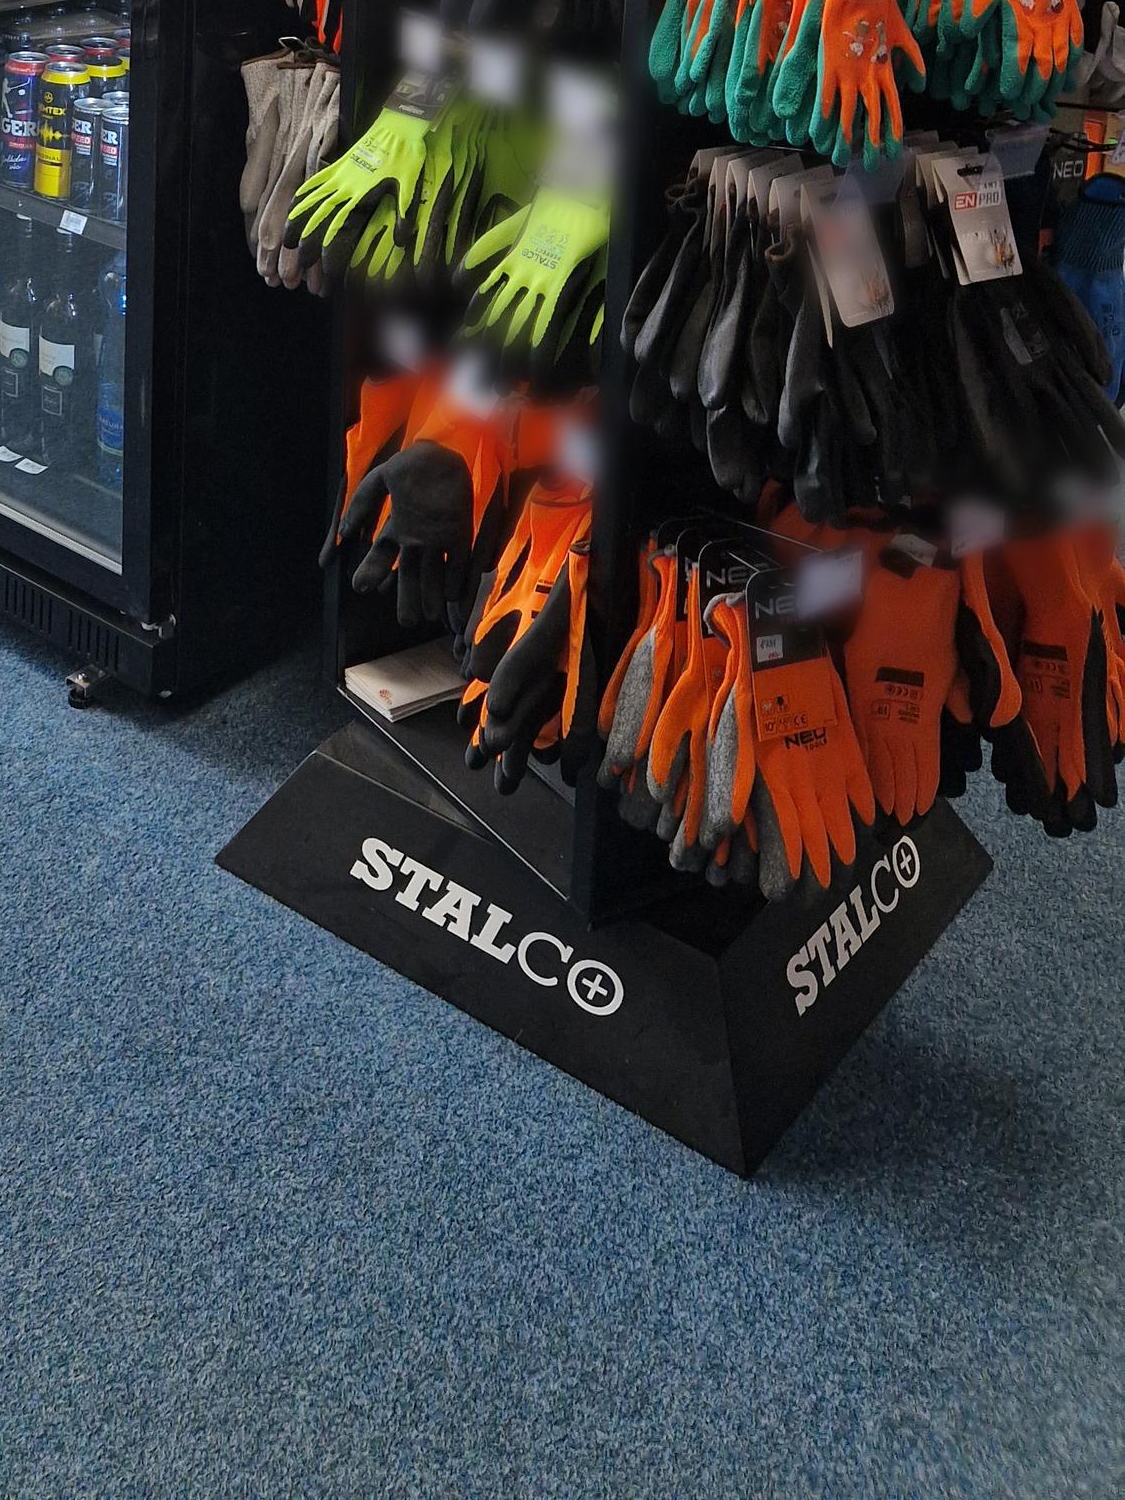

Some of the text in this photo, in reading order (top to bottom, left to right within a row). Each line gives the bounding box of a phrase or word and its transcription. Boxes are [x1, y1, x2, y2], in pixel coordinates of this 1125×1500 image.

[1053, 160, 1084, 180] NEO
[954, 191, 1000, 209] EN PRO
[521, 247, 559, 270] STALCO
[755, 595, 796, 619] NE
[350, 836, 624, 1016] STALCO
[785, 833, 921, 1017] STALCO
